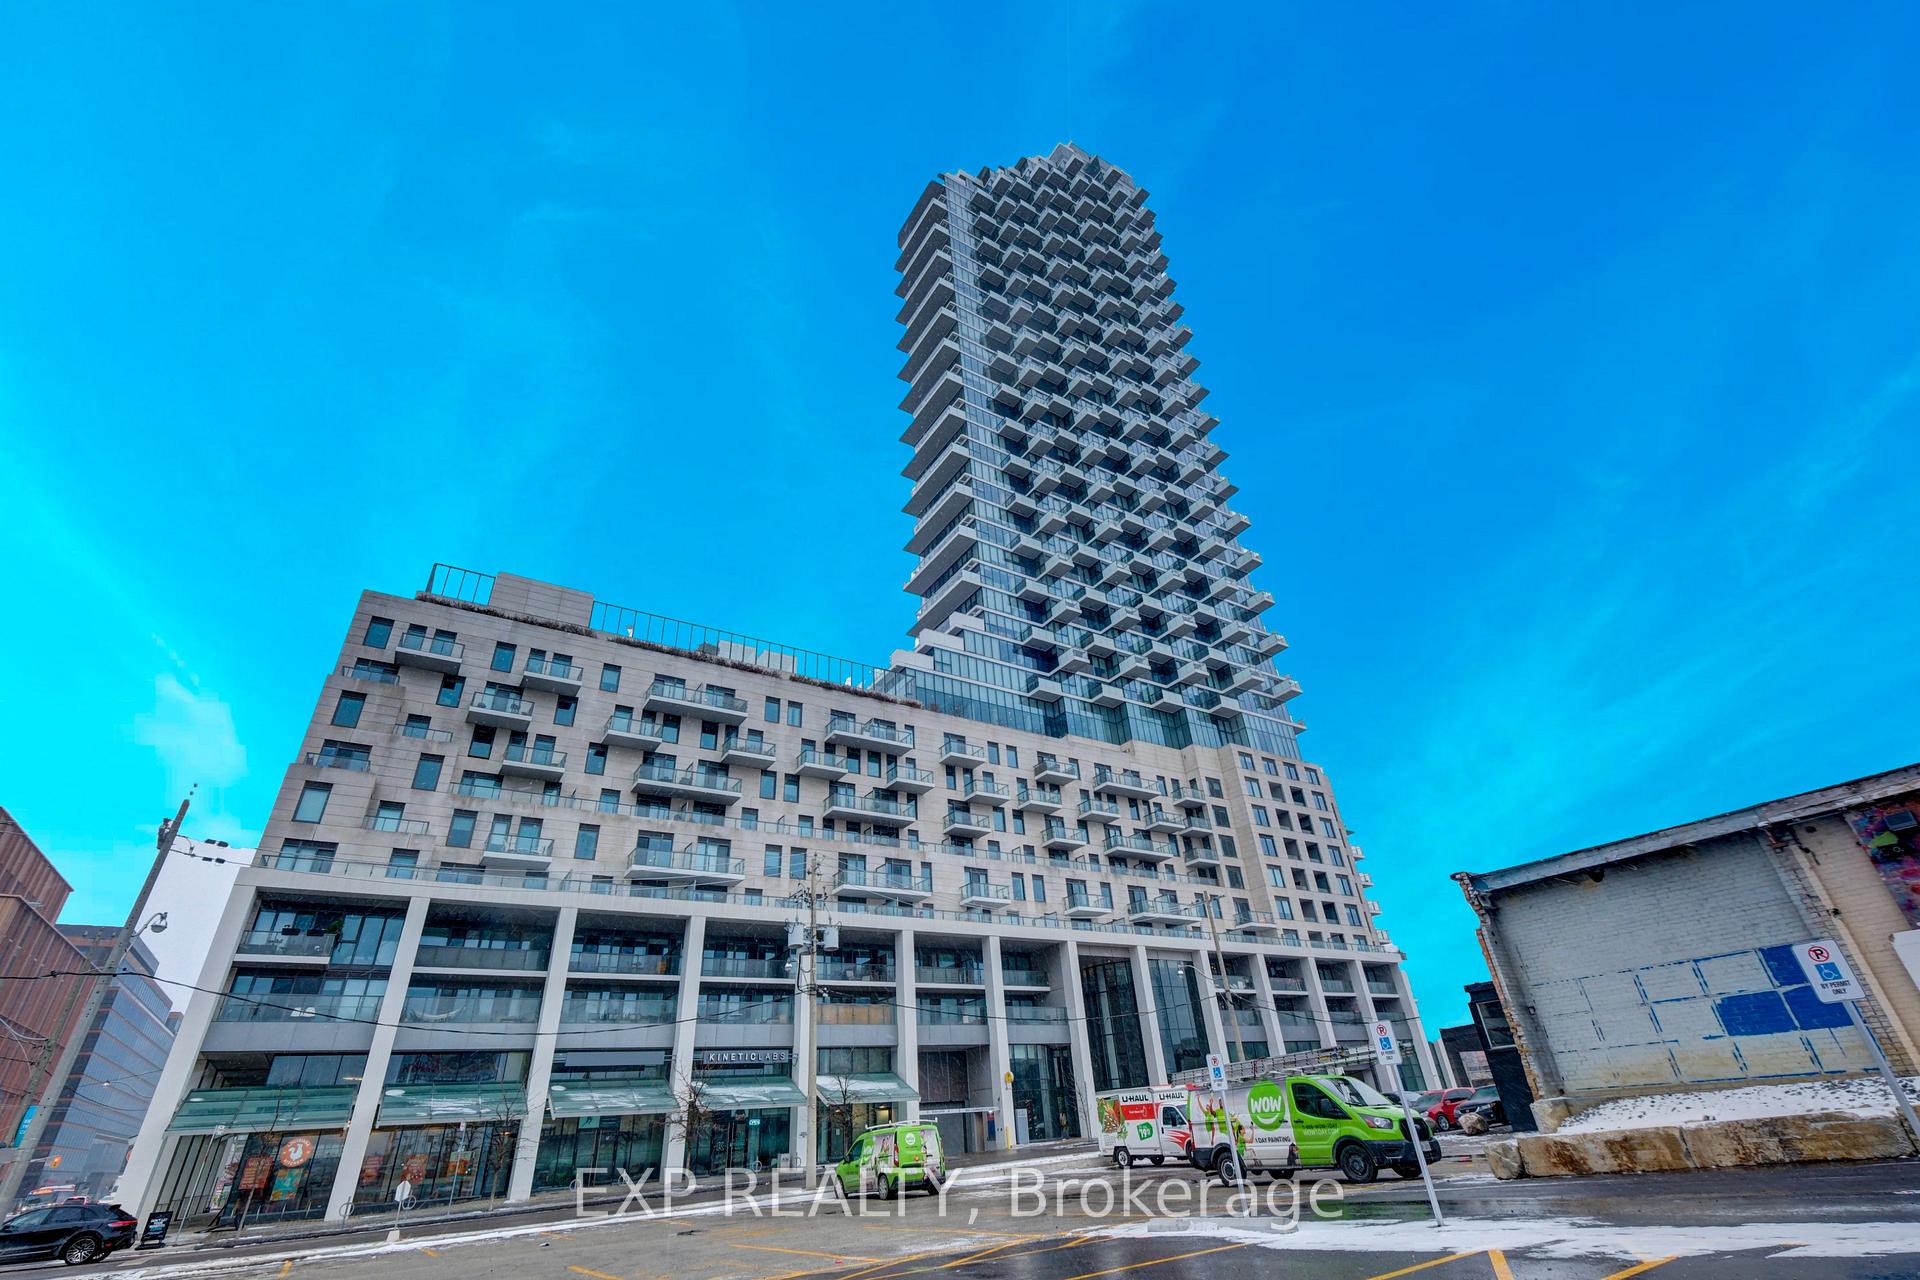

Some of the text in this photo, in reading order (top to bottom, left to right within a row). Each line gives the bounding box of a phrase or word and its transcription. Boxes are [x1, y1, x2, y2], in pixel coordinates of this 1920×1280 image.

[1831, 980, 1850, 988] PERMIT
[709, 1052, 786, 1061] KINETICLABS
[1121, 1094, 1149, 1102] U-HAUL
[1159, 1092, 1184, 1100] U-HAUL
[1250, 1096, 1281, 1113] WOW
[1267, 1135, 1291, 1143] PAINTING
